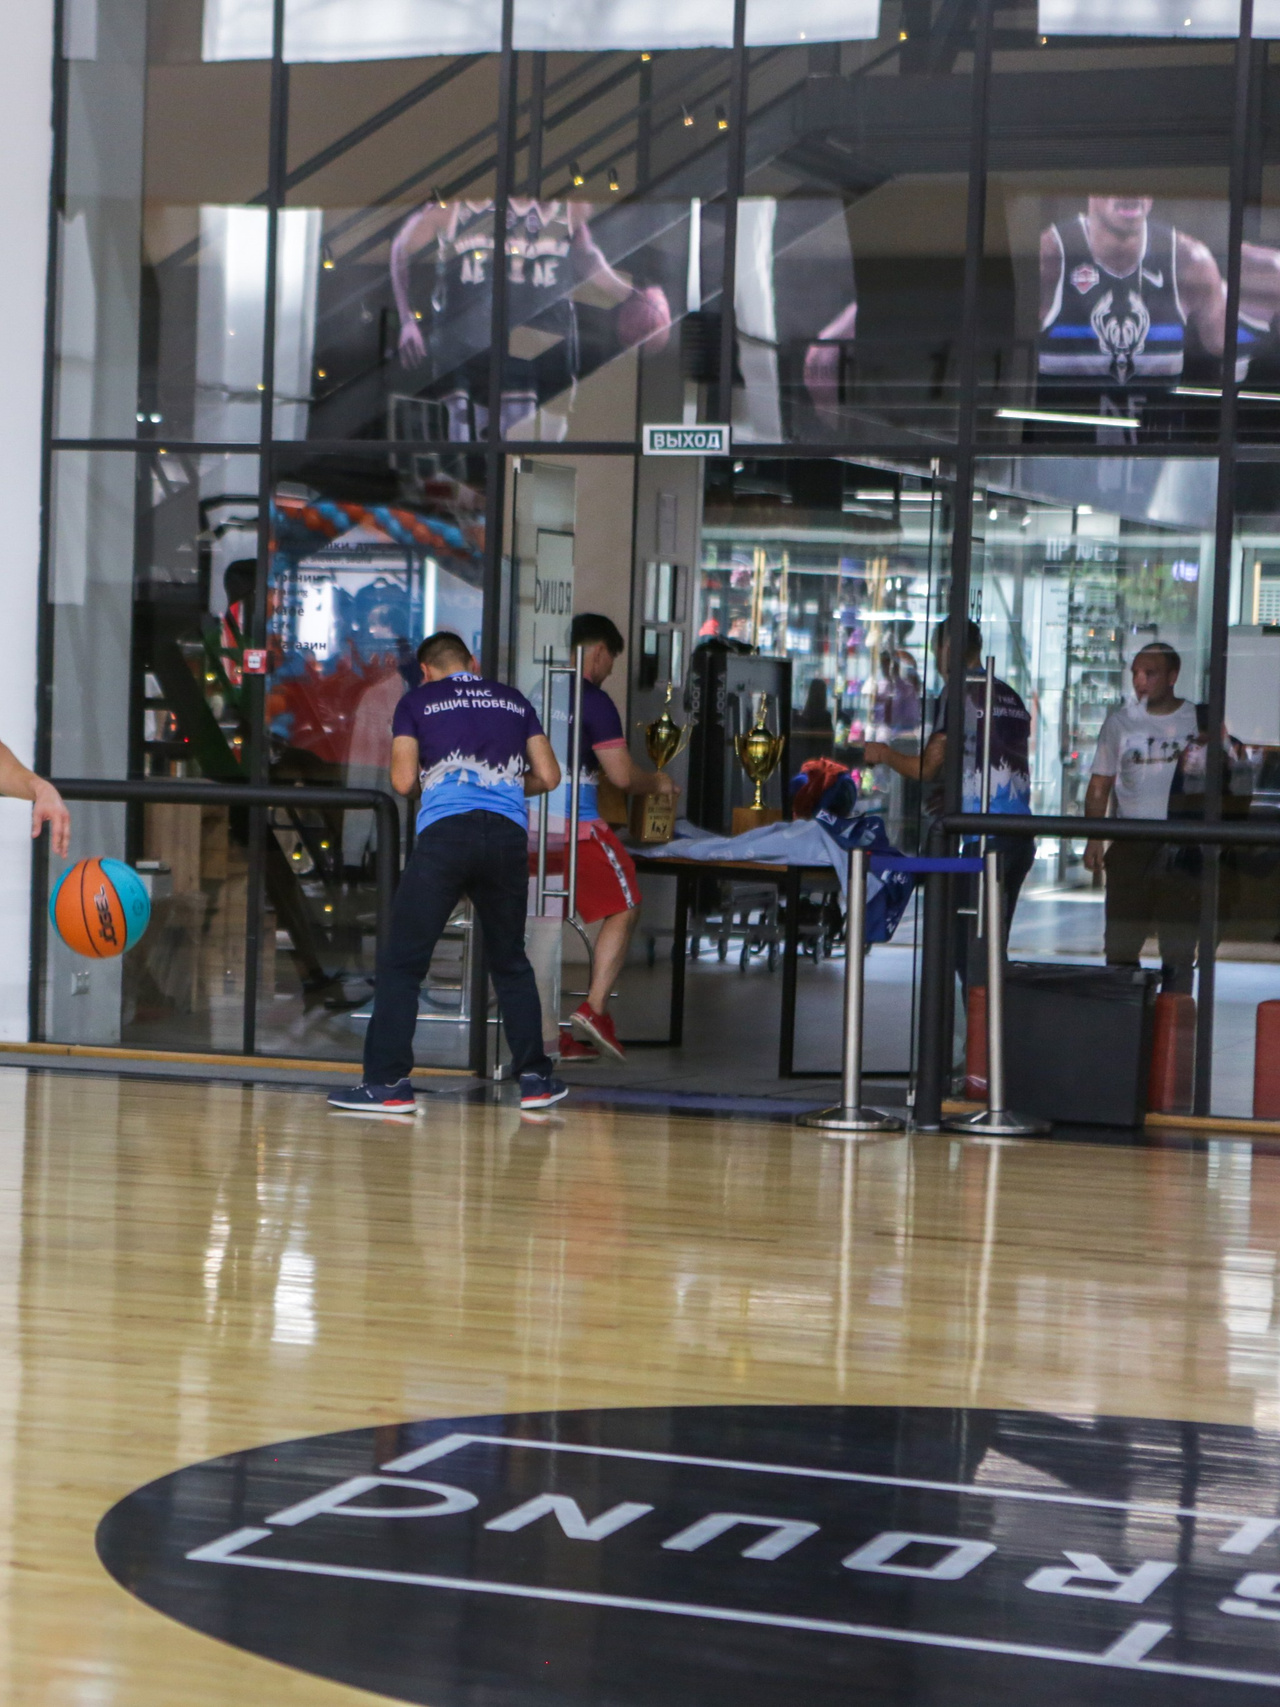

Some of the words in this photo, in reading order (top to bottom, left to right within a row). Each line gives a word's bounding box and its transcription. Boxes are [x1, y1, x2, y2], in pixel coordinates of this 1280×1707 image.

[653, 432, 721, 450] ВЫХОД
[273, 640, 327, 651] аазин
[454, 689, 463, 697] У
[466, 689, 492, 697] НАС
[423, 699, 470, 716] ОБЩИЕ
[472, 699, 526, 718] ПОБЕДЫ!
